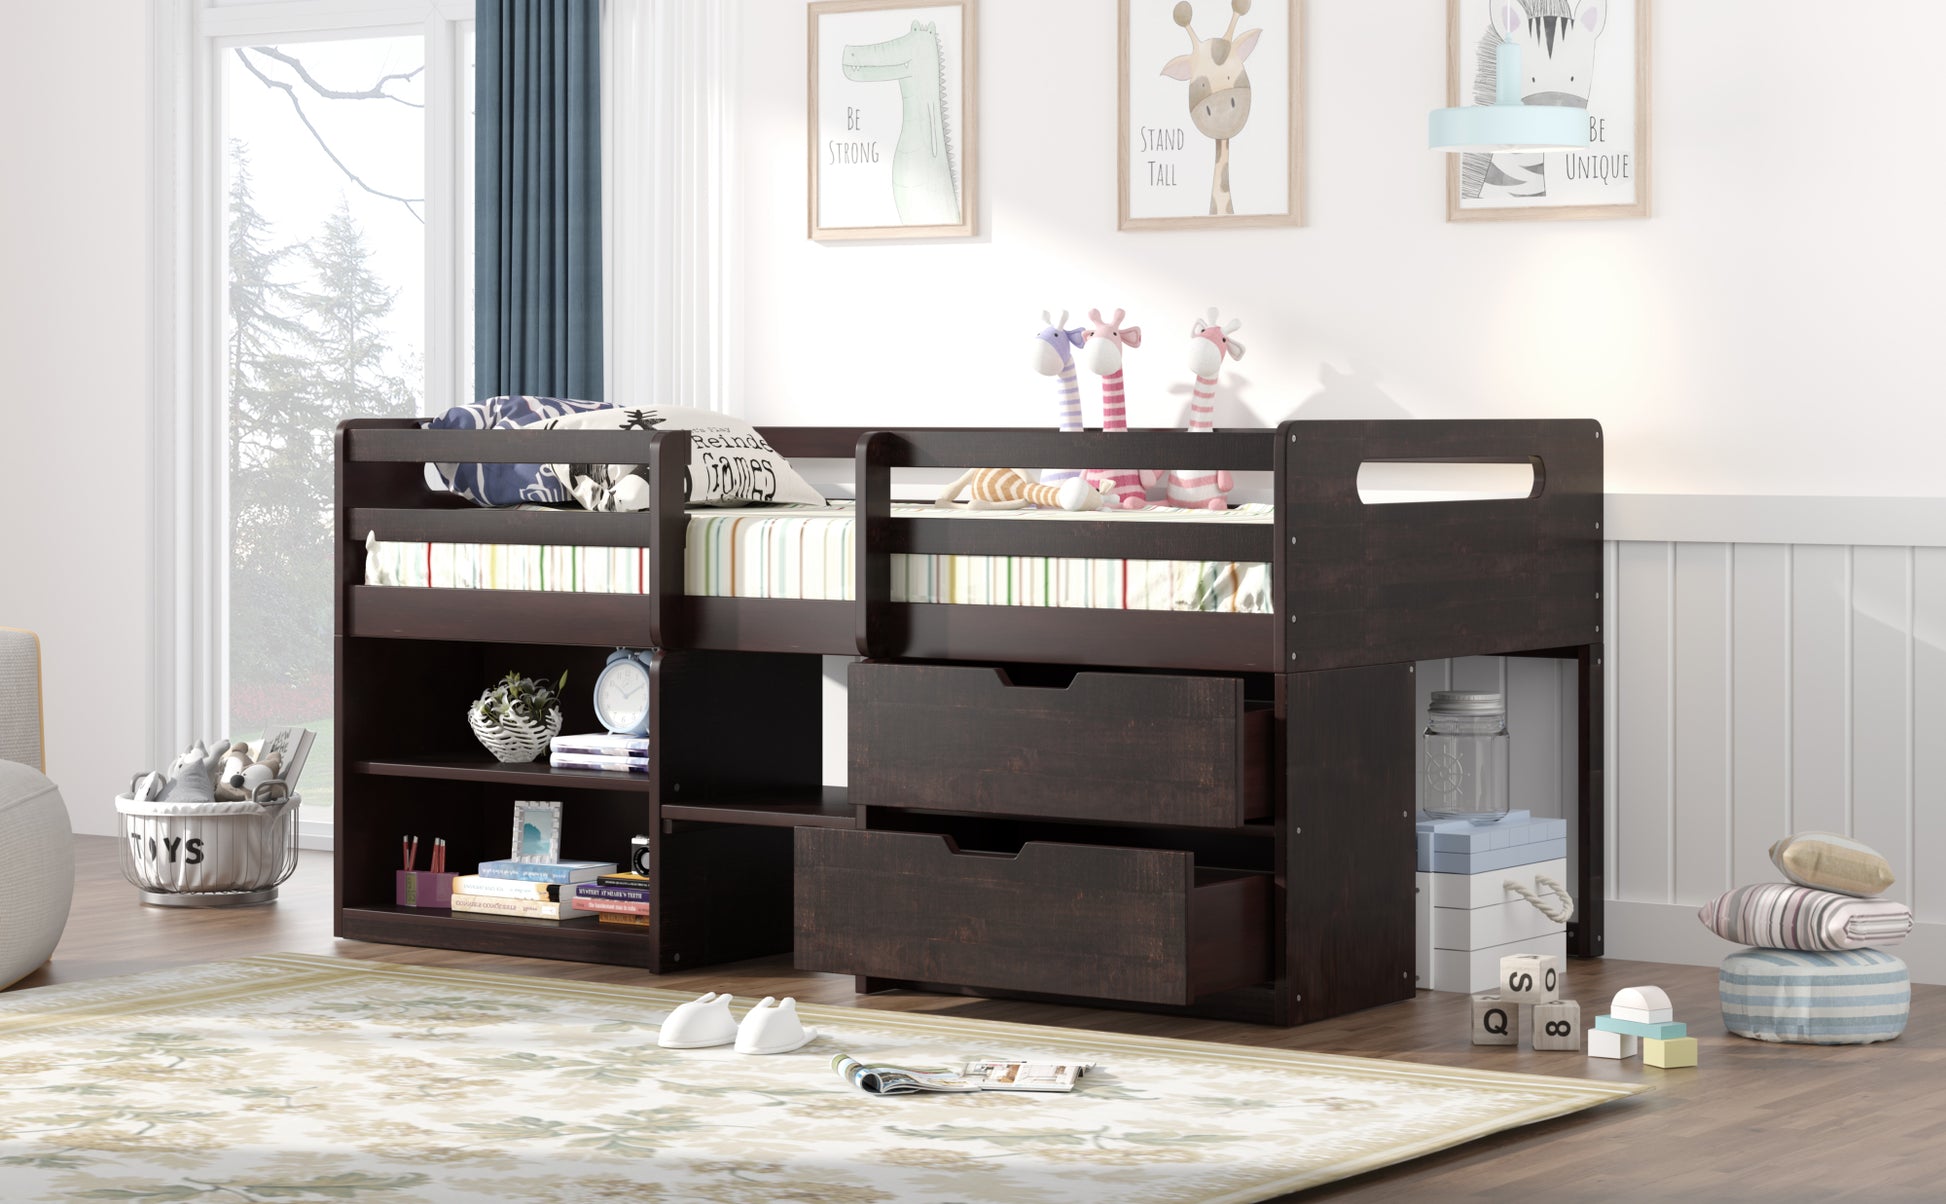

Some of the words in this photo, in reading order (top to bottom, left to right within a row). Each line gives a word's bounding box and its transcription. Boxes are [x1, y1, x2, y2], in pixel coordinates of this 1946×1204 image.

[847, 106, 861, 131] BE
[1589, 115, 1606, 142] BE
[828, 139, 880, 166] STRONG
[1140, 126, 1184, 152] STAND
[1147, 160, 1177, 187] TALL
[1565, 152, 1629, 186] UNIQUE
[1483, 1008, 1508, 1036] Q
[1545, 1020, 1571, 1037] 8
